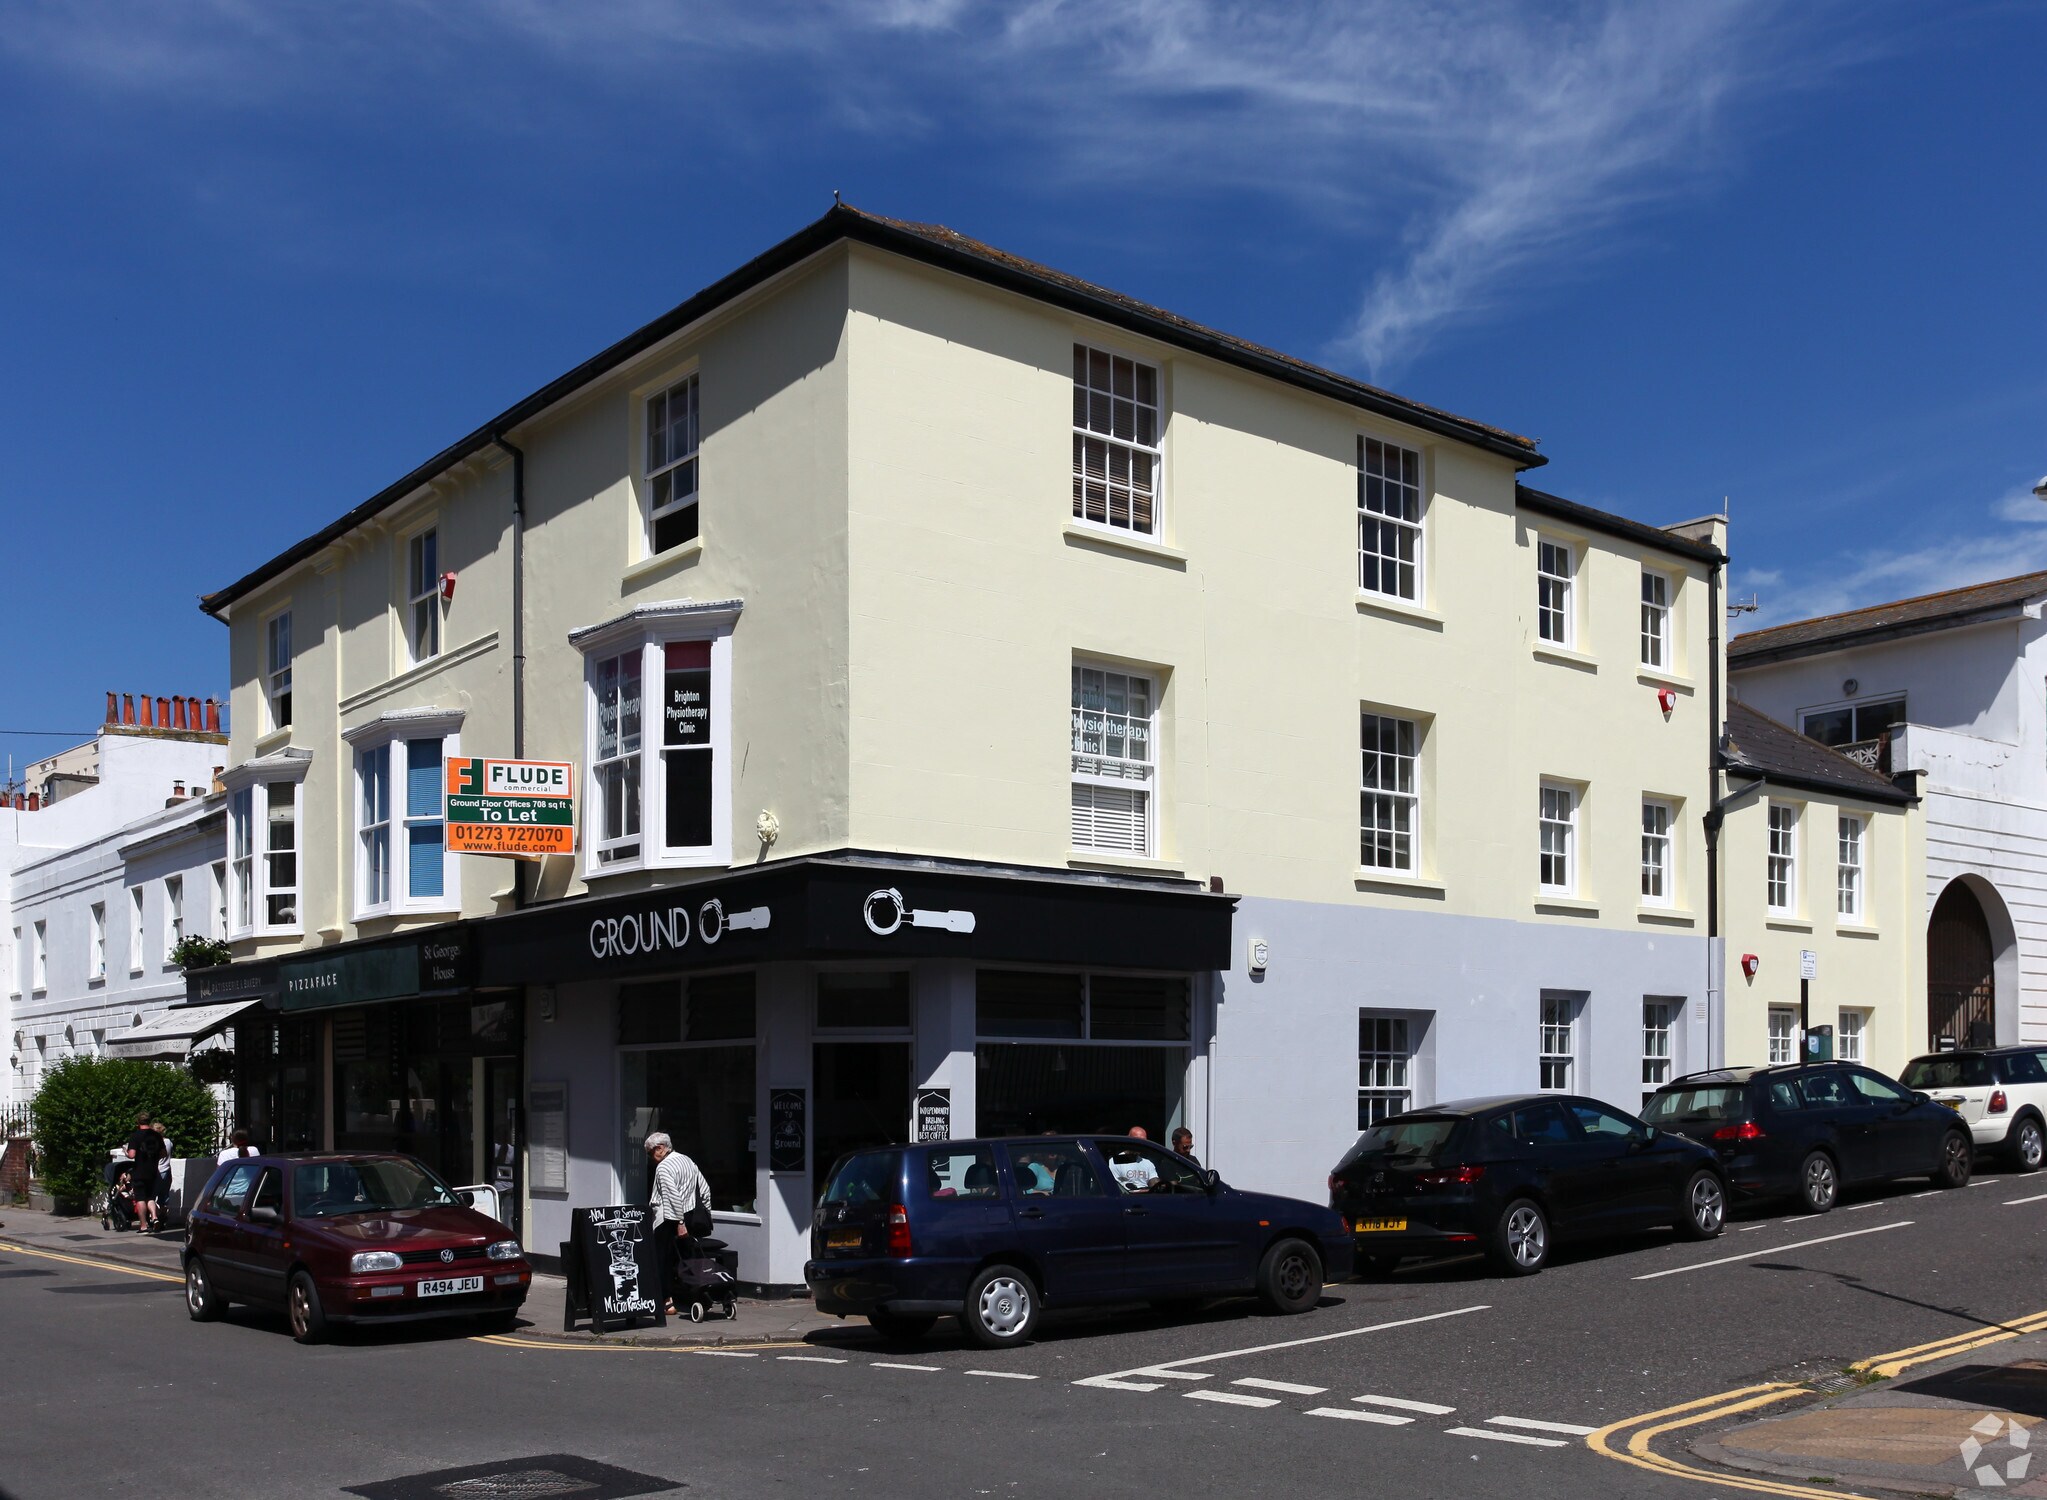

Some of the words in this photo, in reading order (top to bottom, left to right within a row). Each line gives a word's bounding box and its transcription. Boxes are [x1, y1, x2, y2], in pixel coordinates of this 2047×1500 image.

[674, 690, 700, 704] Brighton
[666, 706, 708, 721] Physiotherapy
[679, 721, 696, 734] Clinic
[492, 766, 563, 785] FLUDE
[503, 784, 552, 792] commercial
[450, 799, 480, 807] Ground
[503, 800, 531, 808] Offices
[548, 802, 558, 810] sq
[559, 801, 566, 809] ft
[479, 808, 502, 821] To
[508, 808, 537, 822] Let
[456, 826, 503, 840] 01273
[507, 827, 563, 842] 727070
[463, 842, 557, 853] www.flude.com
[590, 906, 690, 958] GROUND
[424, 945, 432, 960] St
[432, 966, 456, 981] House
[289, 973, 337, 992] PIZZAFACE
[773, 1102, 803, 1111] WELCOME
[919, 1131, 930, 1140] BEST
[930, 1131, 947, 1140] COFFEE
[774, 1139, 801, 1150] ground
[423, 1281, 453, 1295] R494
[457, 1277, 479, 1291] JEU
